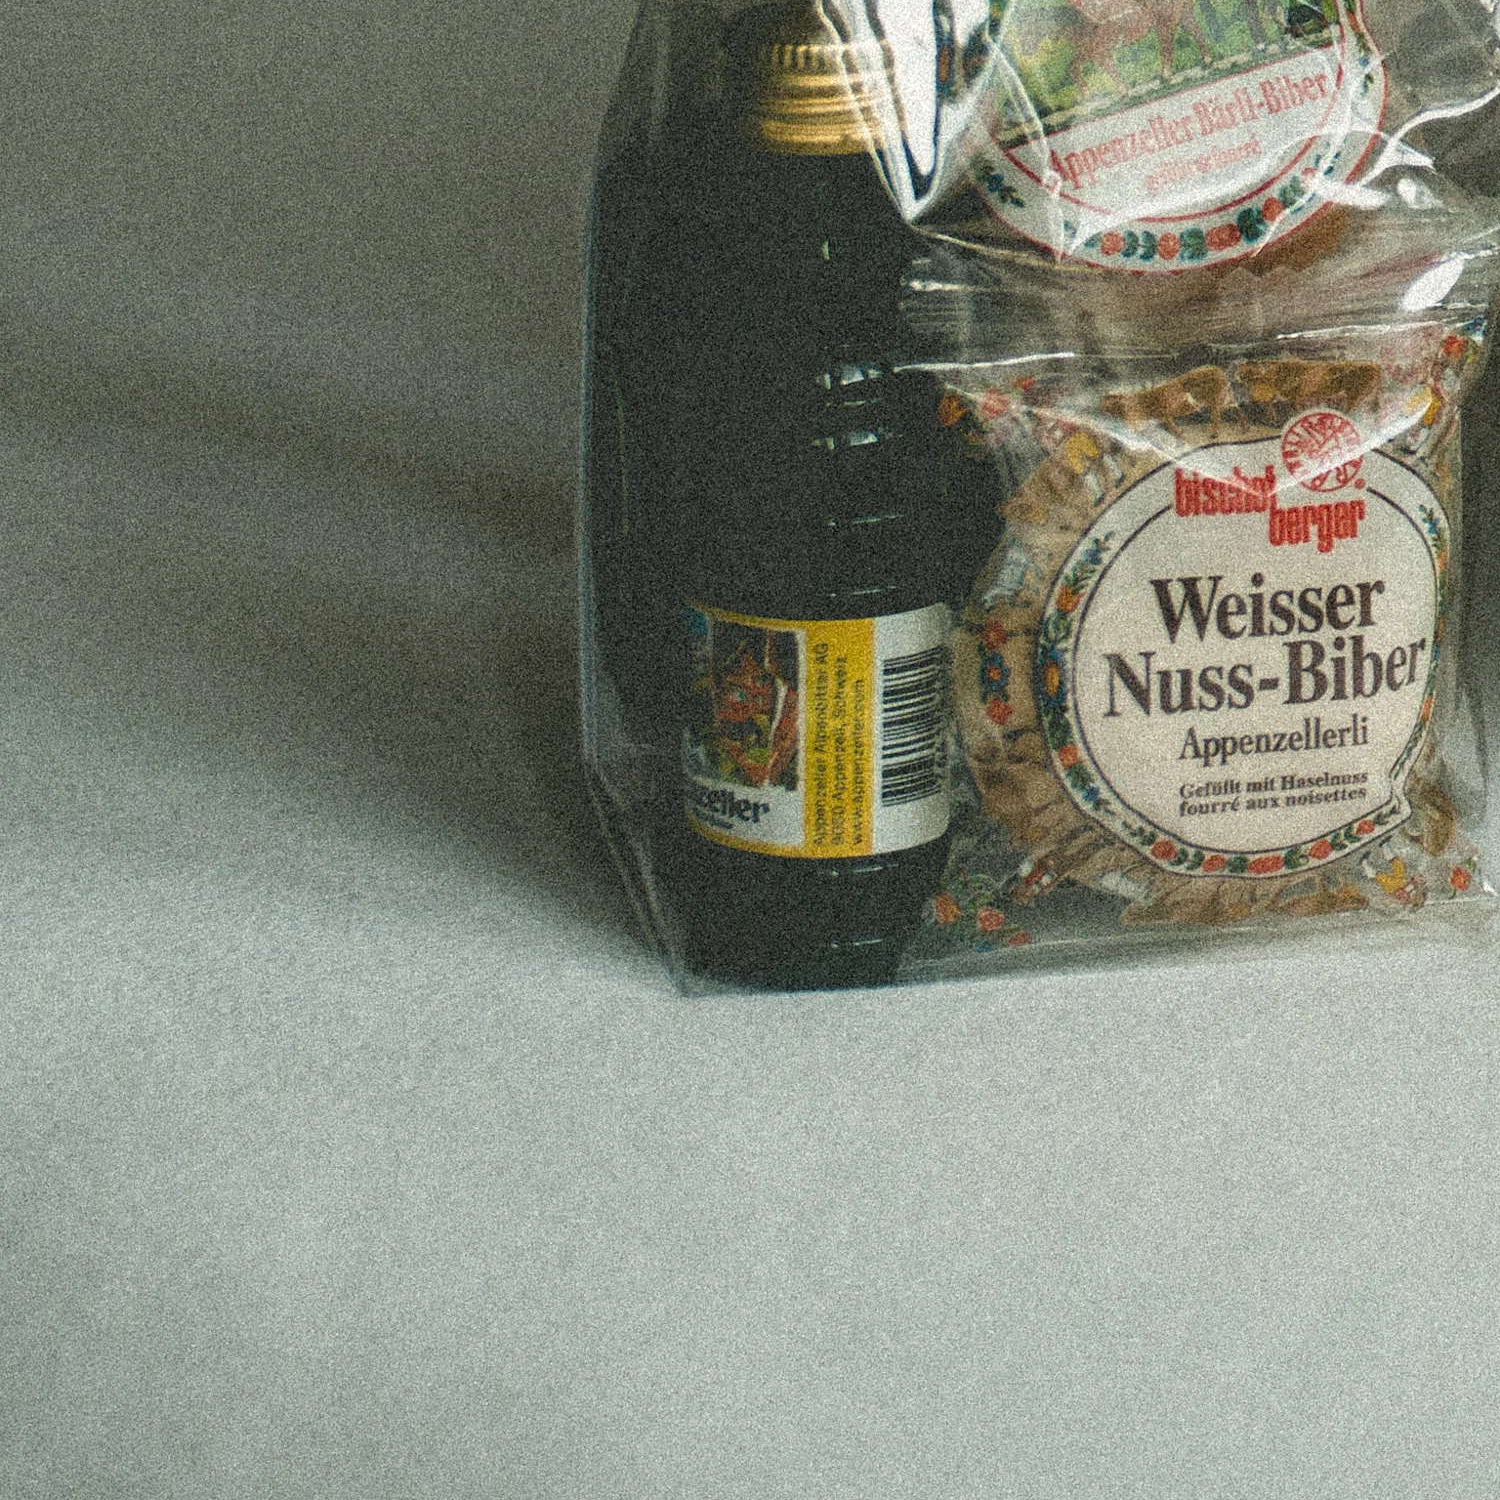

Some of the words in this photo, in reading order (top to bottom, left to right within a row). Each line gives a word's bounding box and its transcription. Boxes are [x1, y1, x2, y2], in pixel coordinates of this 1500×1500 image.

[1050, 114, 1193, 190] Appenzeller
[1268, 493, 1366, 554] berger
[1150, 572, 1386, 645] Weisser
[1103, 635, 1427, 719] Nuss-Biber
[1178, 713, 1370, 768] Appenzellerli
[1178, 779, 1242, 800] Gefüllt
[1246, 776, 1275, 793] mit
[1280, 771, 1369, 791] Haselnuss
[1178, 796, 1241, 818] fourré
[1245, 798, 1280, 811] aux
[1284, 786, 1368, 807] noisettes
